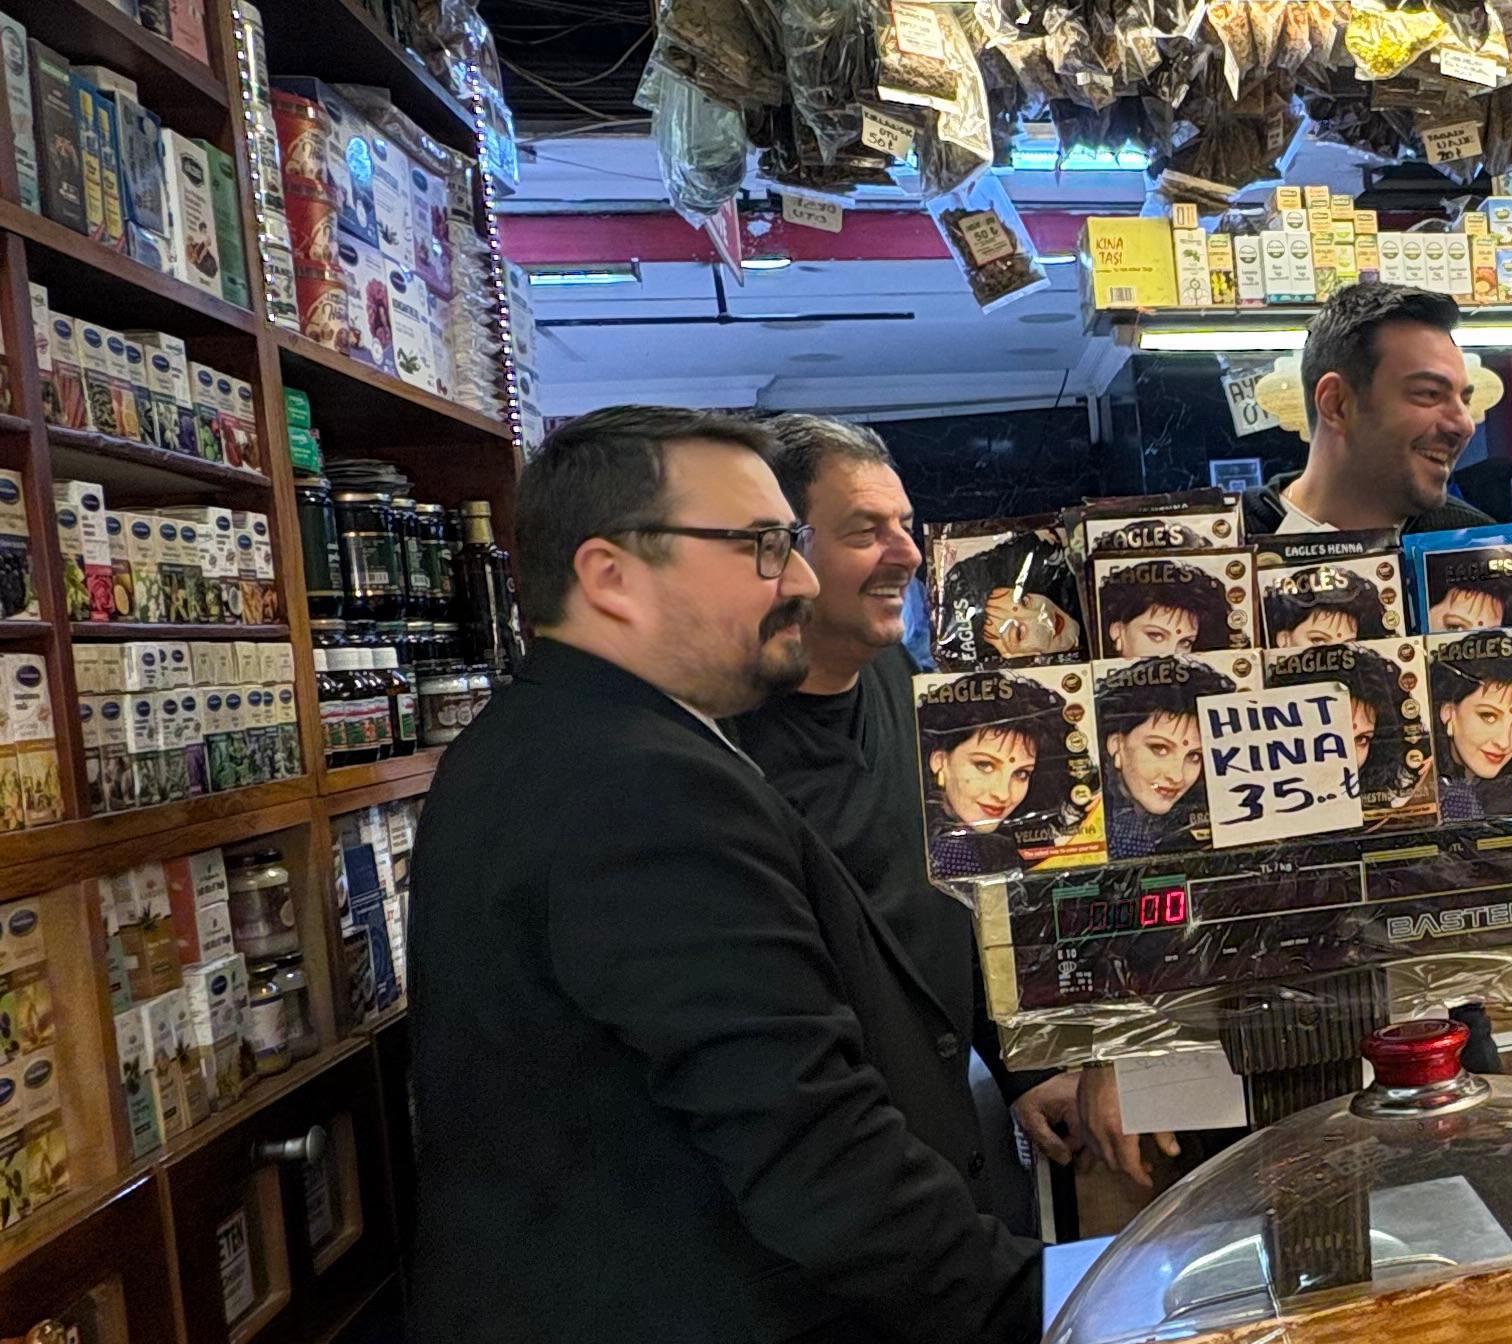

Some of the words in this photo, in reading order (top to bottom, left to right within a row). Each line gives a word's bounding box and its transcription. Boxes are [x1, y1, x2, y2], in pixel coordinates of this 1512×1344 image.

[1096, 238, 1123, 252] KINA
[1099, 251, 1122, 265] TAŞI
[1229, 375, 1262, 403] AY
[1103, 525, 1184, 549] EAGLE'S
[1285, 544, 1326, 557] EAGLE'S
[1328, 542, 1363, 554] HENNA
[1109, 563, 1193, 584] EAGLE'S
[1272, 569, 1349, 594] EAGLE'S
[953, 598, 976, 661] EAGLE'S
[1438, 637, 1512, 662] EAGLE'S
[1106, 662, 1190, 688] EAGLE'S
[1276, 650, 1356, 676] EAGLE'S
[927, 678, 1014, 704] EAGLE'S
[1210, 732, 1348, 776] KINA
[1190, 812, 1210, 825] BRO
